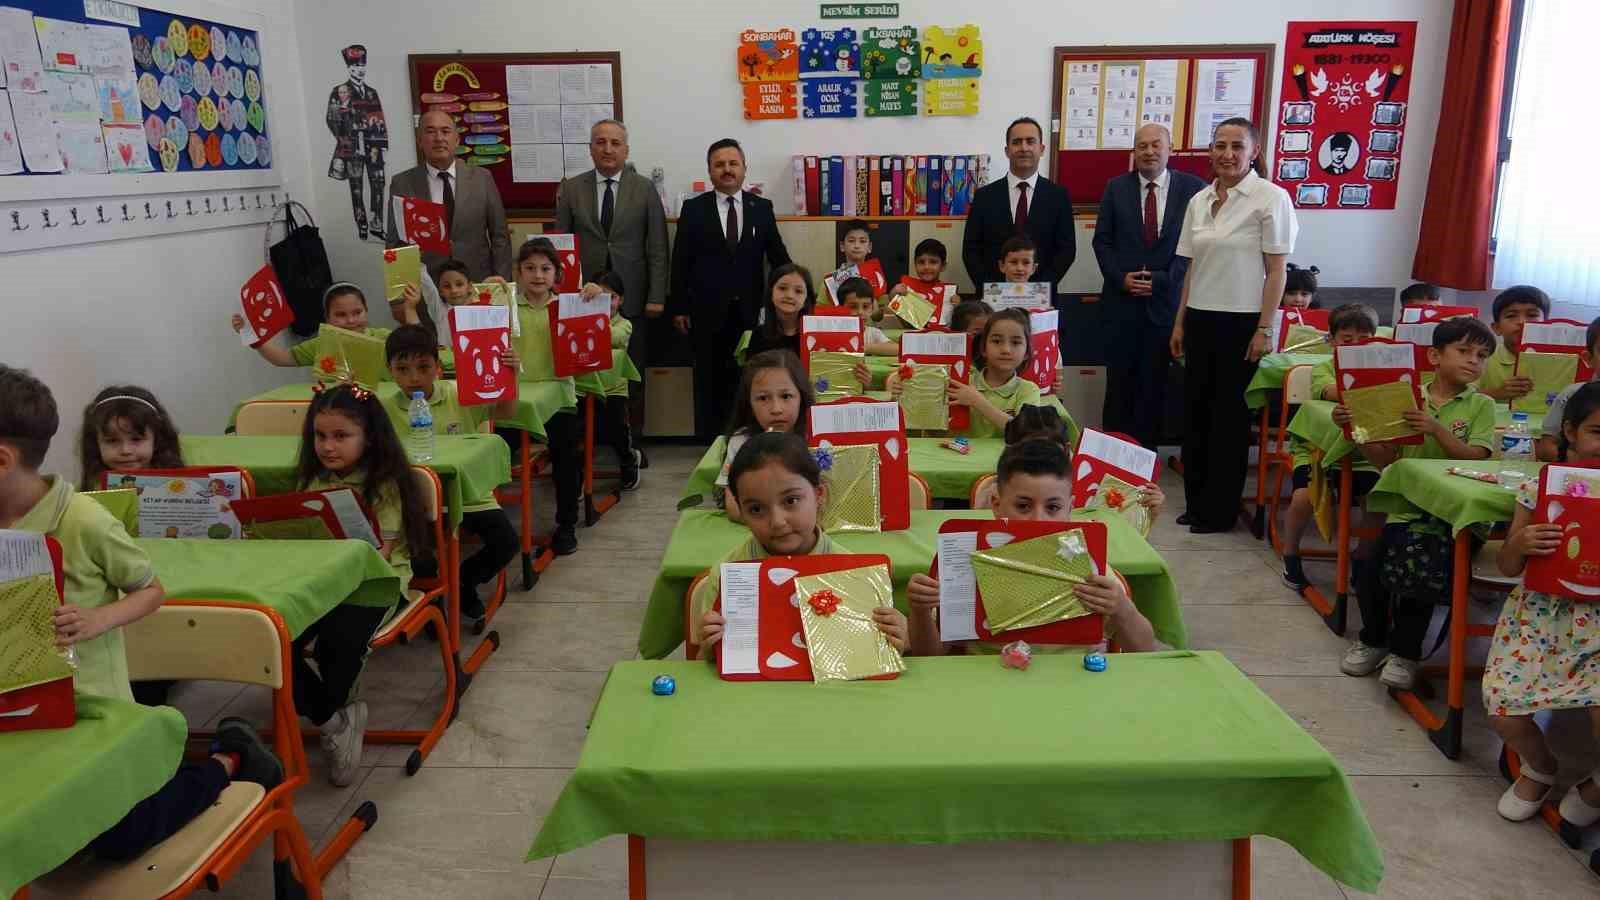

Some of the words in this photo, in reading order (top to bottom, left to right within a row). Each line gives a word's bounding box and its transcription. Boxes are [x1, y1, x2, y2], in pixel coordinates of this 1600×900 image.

[823, 5, 860, 16] MEVSİM
[864, 4, 898, 15] SERİDİ
[743, 32, 793, 42] SONBAHAR
[821, 31, 835, 42] KIŞ
[1308, 32, 1354, 44] ATATÜRK
[760, 83, 782, 93] EYLÜL
[817, 83, 842, 93] ARALIK
[881, 82, 899, 90] MART
[761, 93, 781, 103] EKİM
[820, 94, 840, 103] OCAK
[881, 90, 900, 100] NİSAN
[759, 104, 784, 114] KASIM
[819, 104, 842, 113] ŞUBAT
[880, 101, 902, 111] MAYIS
